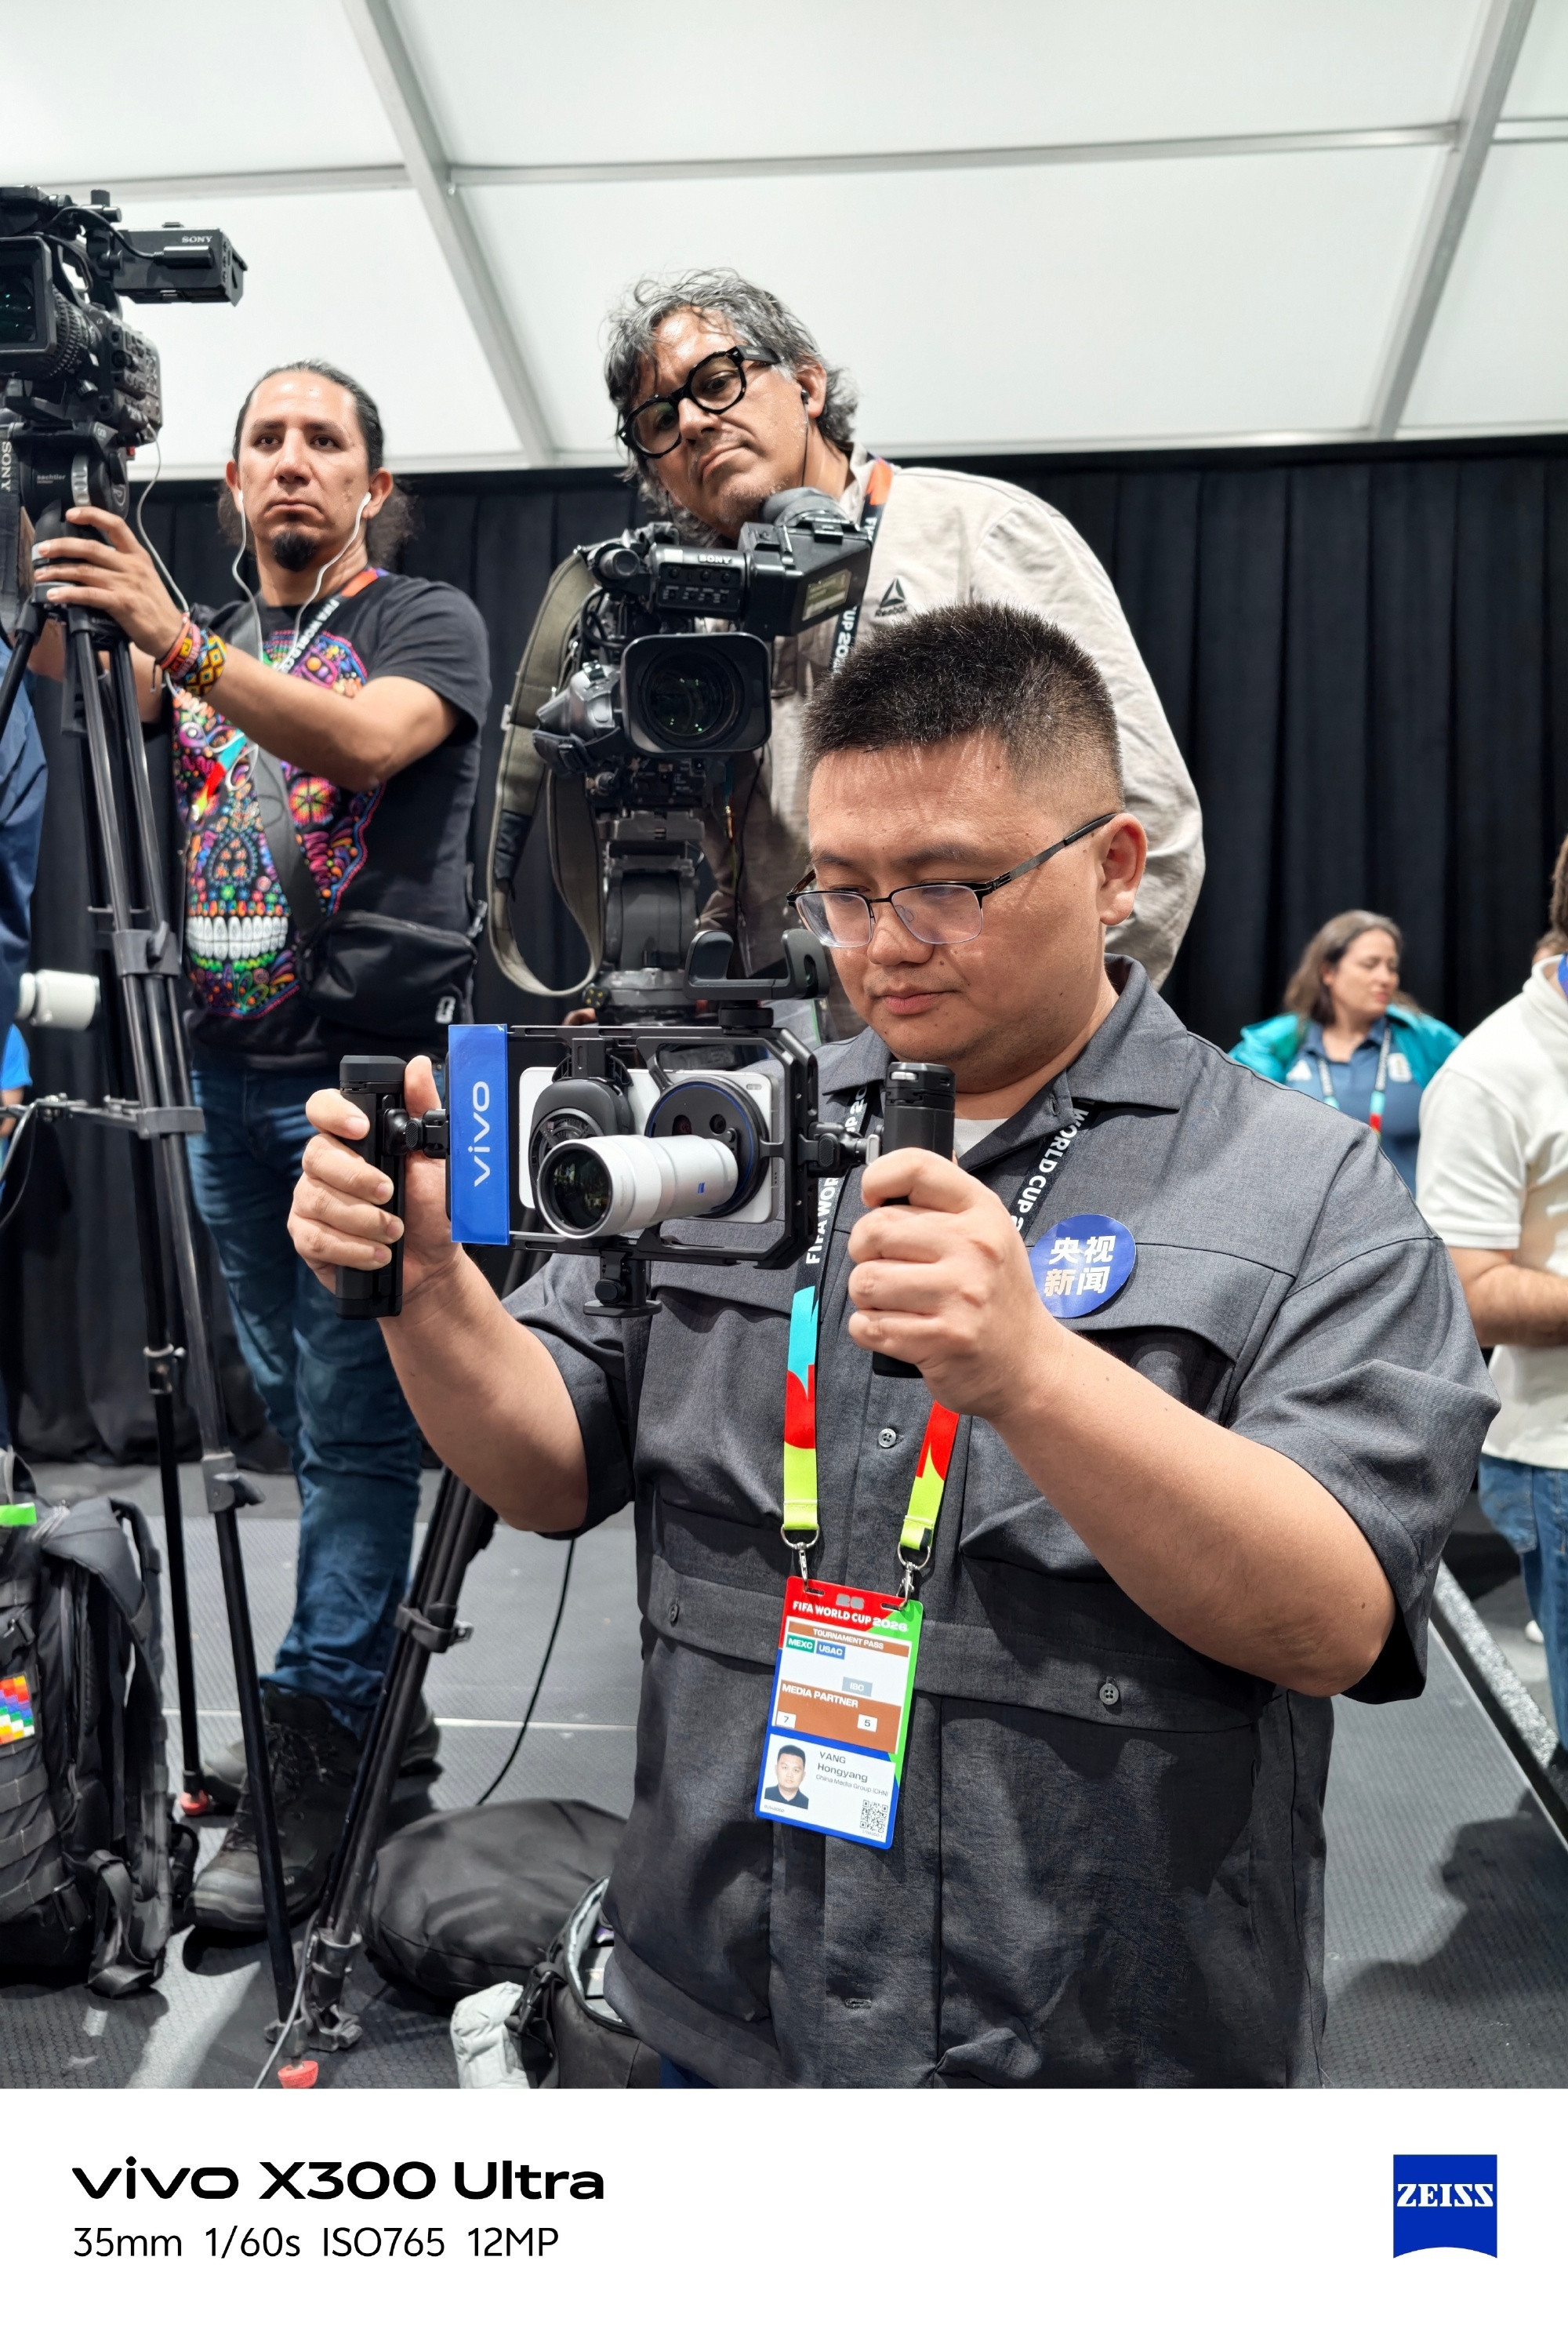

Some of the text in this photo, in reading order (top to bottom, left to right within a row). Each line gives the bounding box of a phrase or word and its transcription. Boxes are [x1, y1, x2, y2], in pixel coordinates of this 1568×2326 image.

[2, 442, 12, 492] SONY
[699, 554, 731, 564] SONY
[840, 605, 858, 631] UP
[468, 1081, 491, 1187] vivo
[1039, 1108, 1089, 1173] WORLD
[818, 1177, 840, 1216] WOR
[1017, 1175, 1047, 1213] CUP
[1048, 1235, 1116, 1265] 央视
[1044, 1266, 1111, 1297] 新闻
[793, 1601, 909, 1632] FIFA WORLD CUP 2026
[788, 1637, 813, 1649] MEXC
[813, 1628, 884, 1649] TOURNAMENT PASS
[818, 1645, 844, 1655] USAC
[782, 1683, 859, 1708] MEDIA PARTNER
[850, 1682, 865, 1692] IBC
[864, 1719, 871, 1728] 5
[819, 1750, 847, 1764] YANG
[817, 1763, 868, 1783] Hongyang
